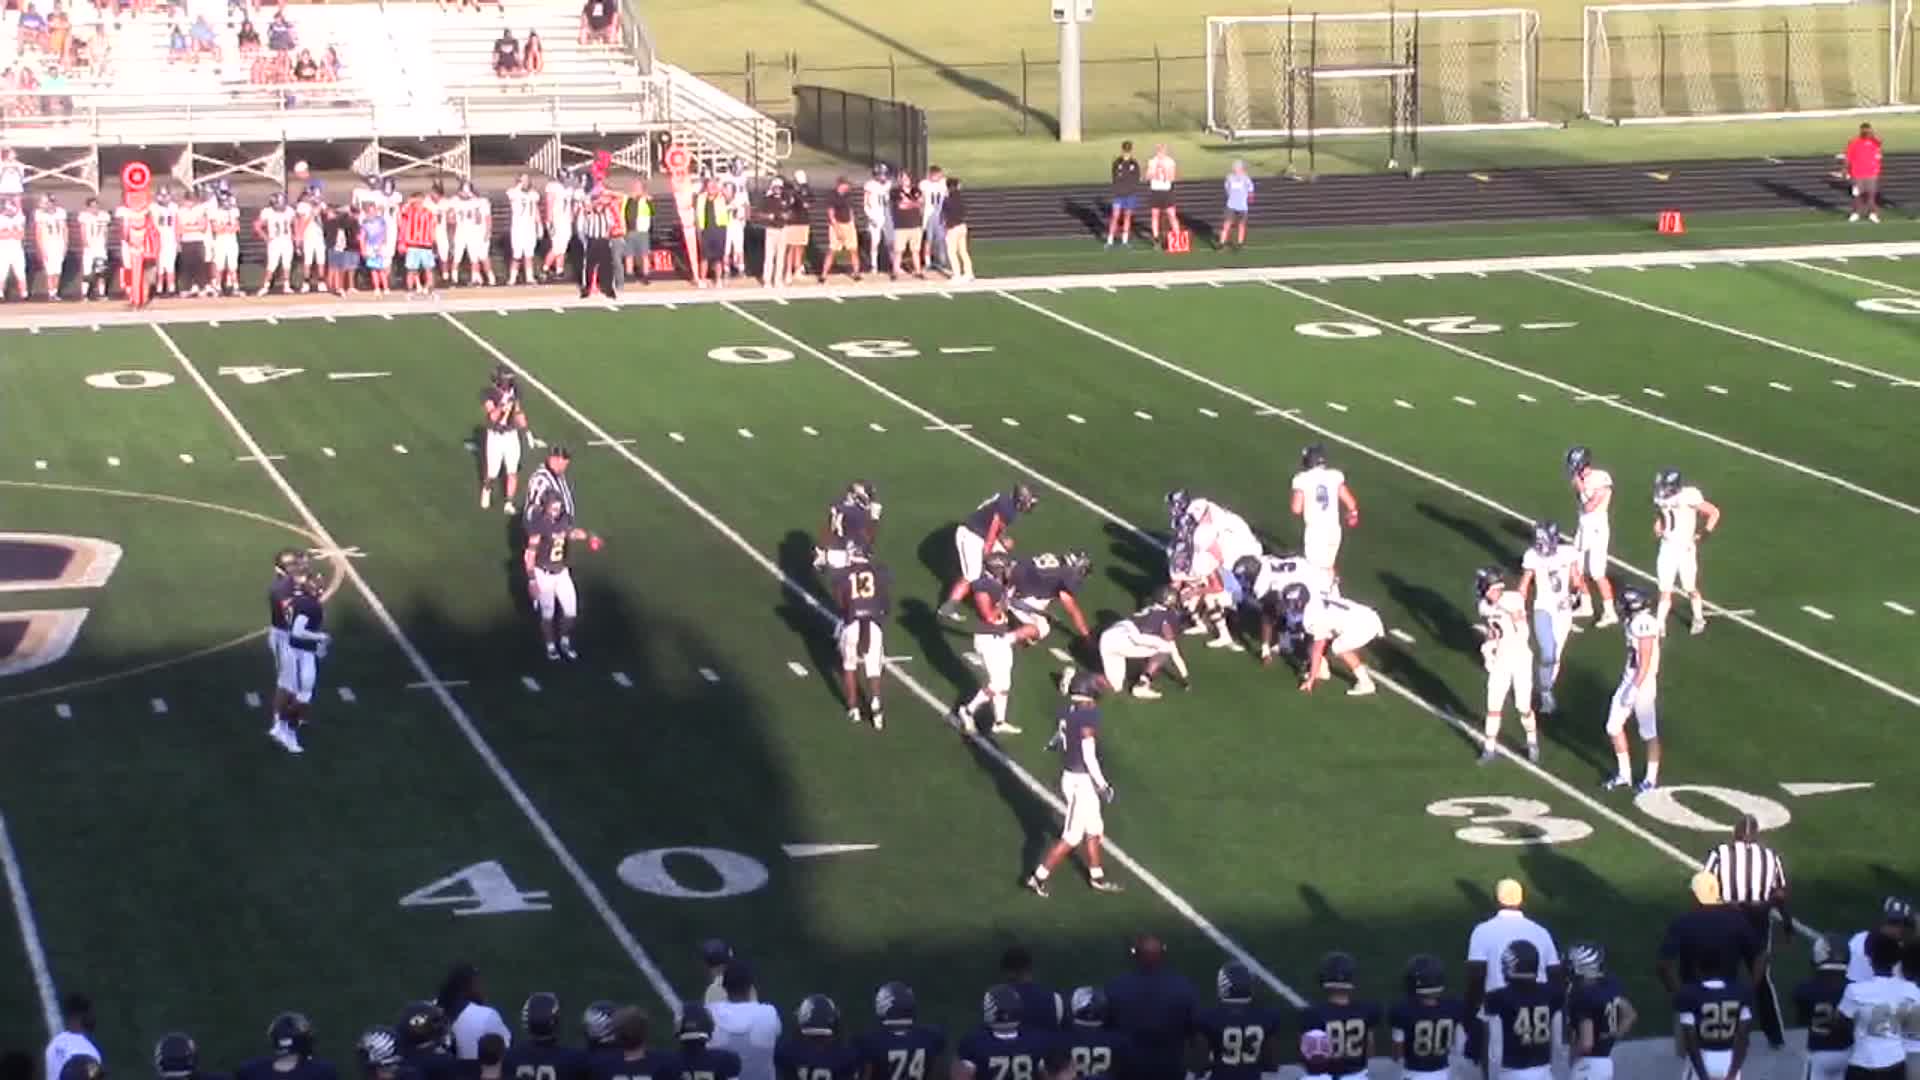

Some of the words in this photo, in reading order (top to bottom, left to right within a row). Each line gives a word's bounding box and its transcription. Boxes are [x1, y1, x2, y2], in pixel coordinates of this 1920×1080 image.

[851, 571, 874, 600] 13
[1414, 1019, 1454, 1056] 80
[1513, 1005, 1553, 1044] 48
[1701, 1002, 1740, 1040] 25
[1222, 1026, 1264, 1064] 93
[888, 1048, 926, 1080] 74
